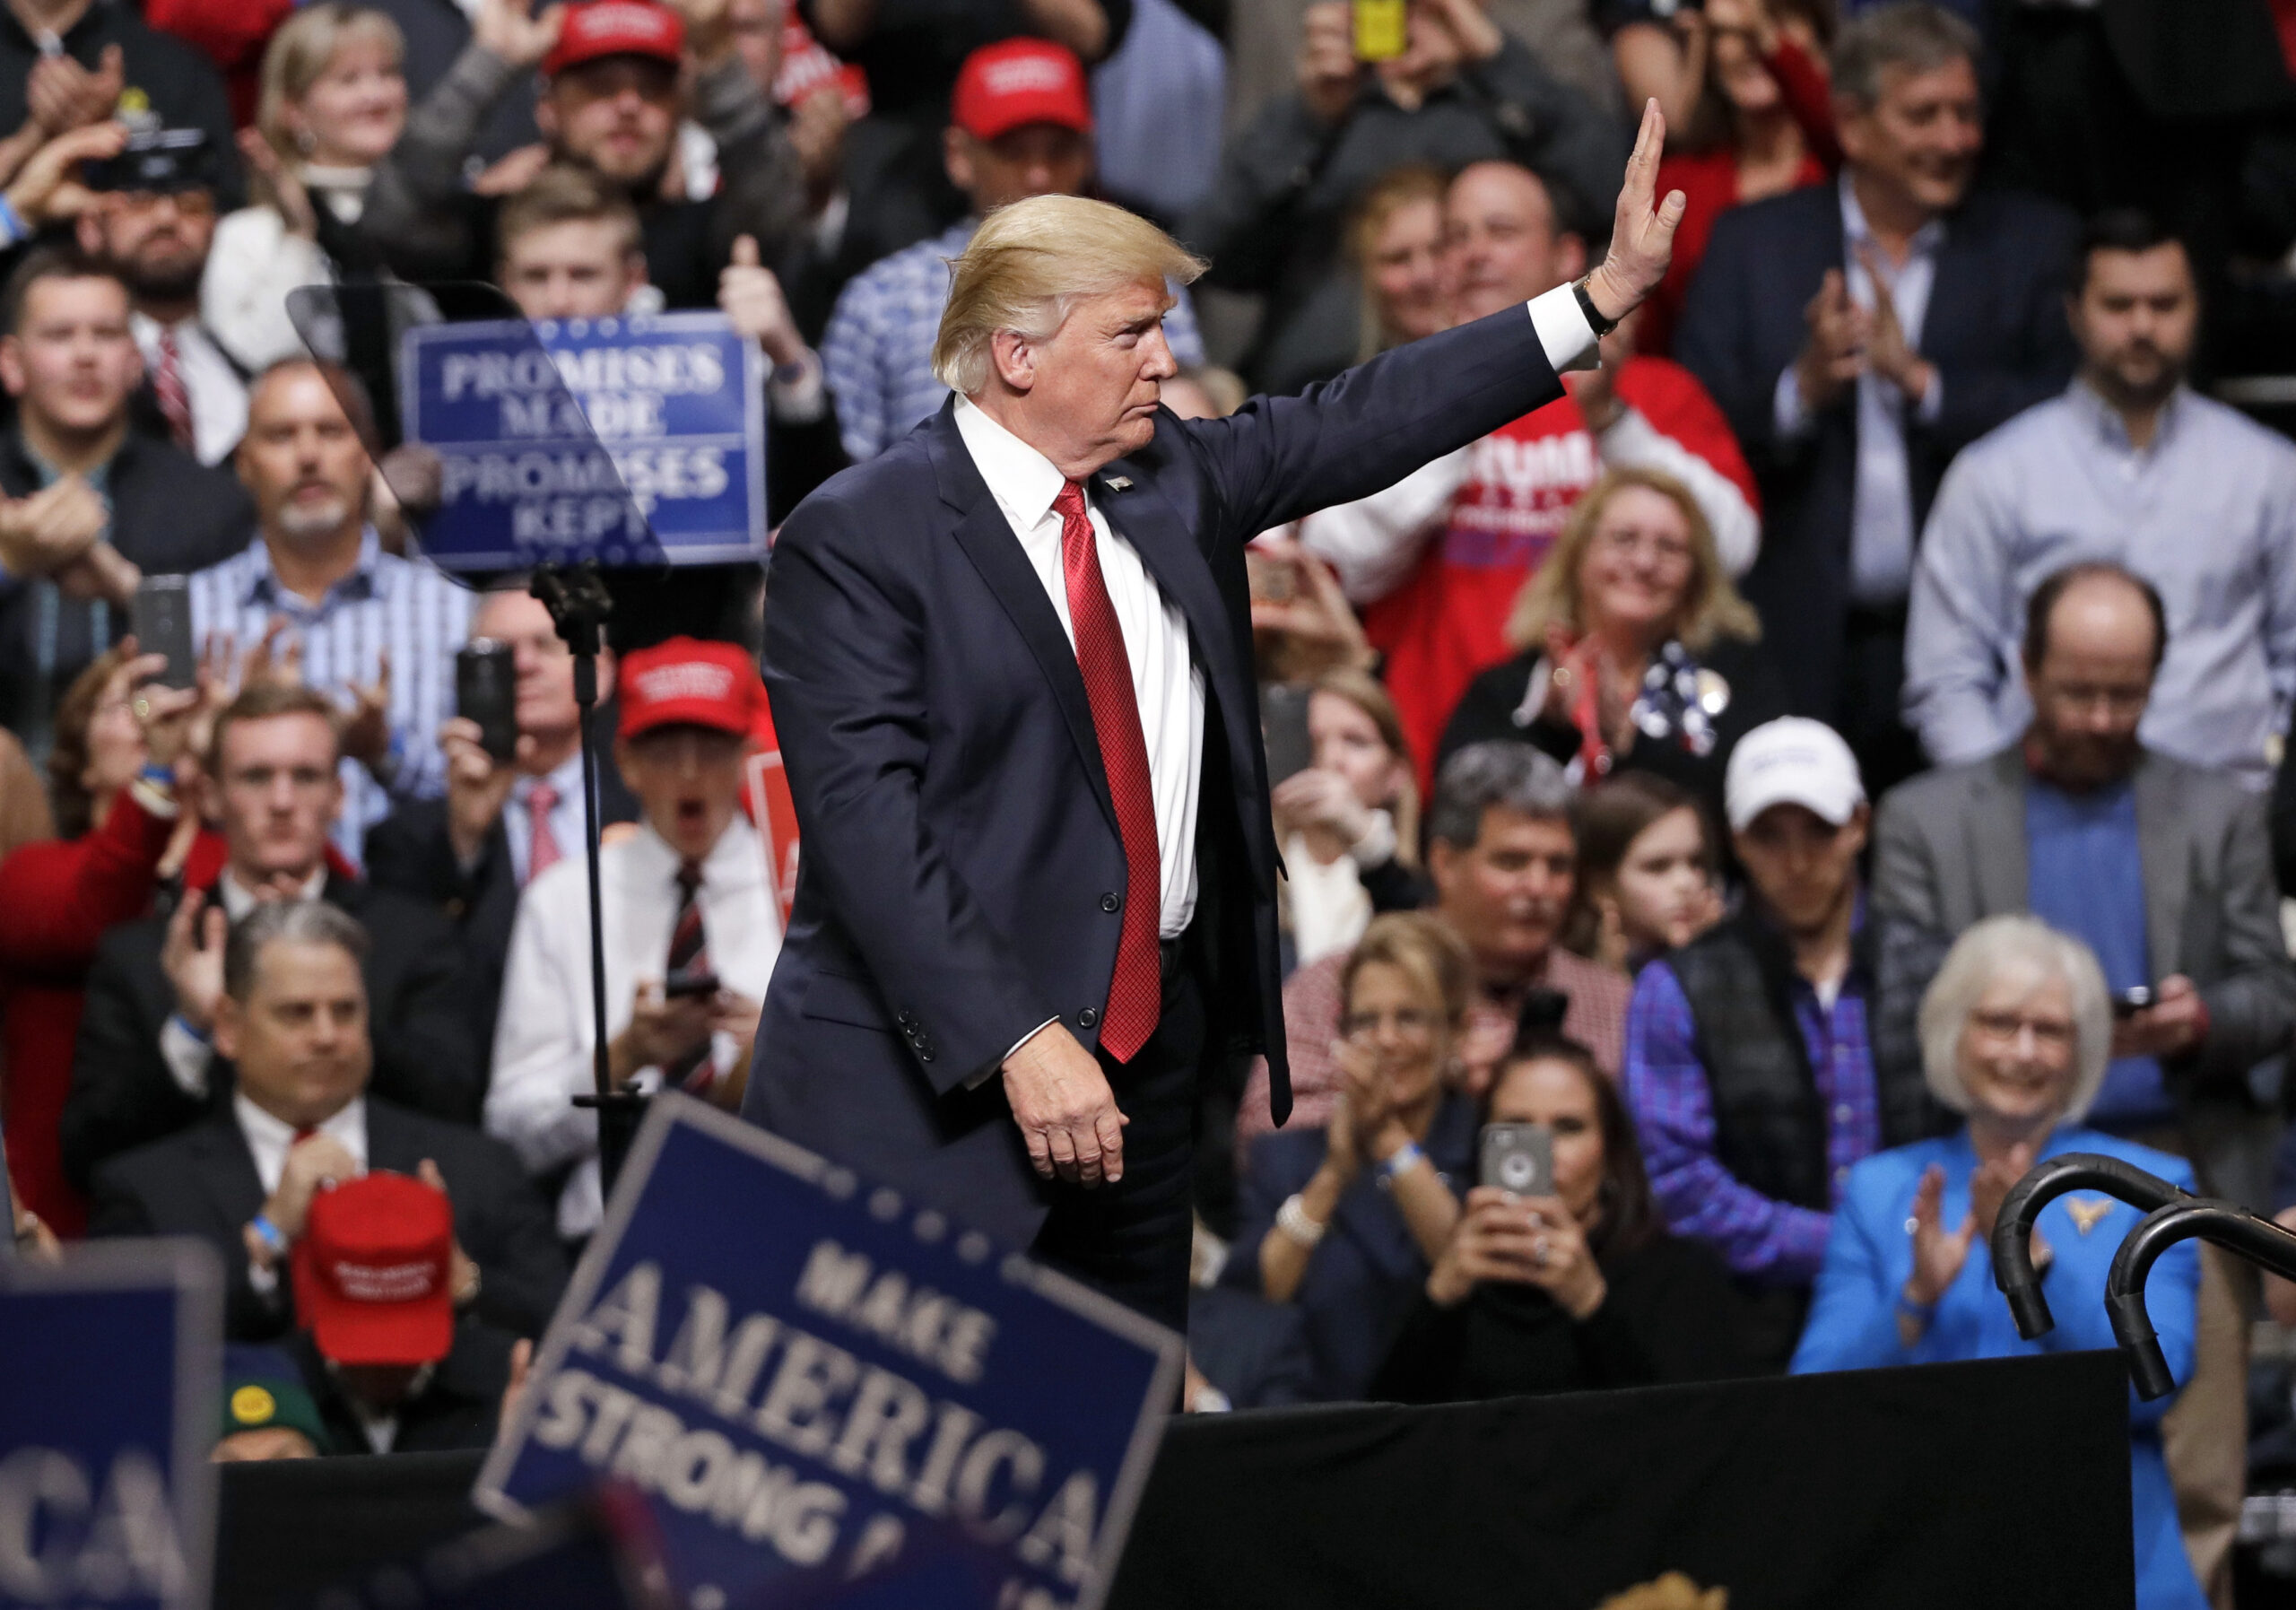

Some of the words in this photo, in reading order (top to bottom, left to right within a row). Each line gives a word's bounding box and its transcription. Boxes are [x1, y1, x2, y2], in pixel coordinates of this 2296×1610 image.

[443, 344, 725, 401] PROMISES
[500, 390, 667, 436] MADE
[442, 447, 728, 503] PROMISES
[513, 494, 657, 546] KEPT
[796, 1239, 996, 1384] MAKE
[569, 1262, 1096, 1586] AMERICA
[540, 1369, 848, 1568] STRONG
